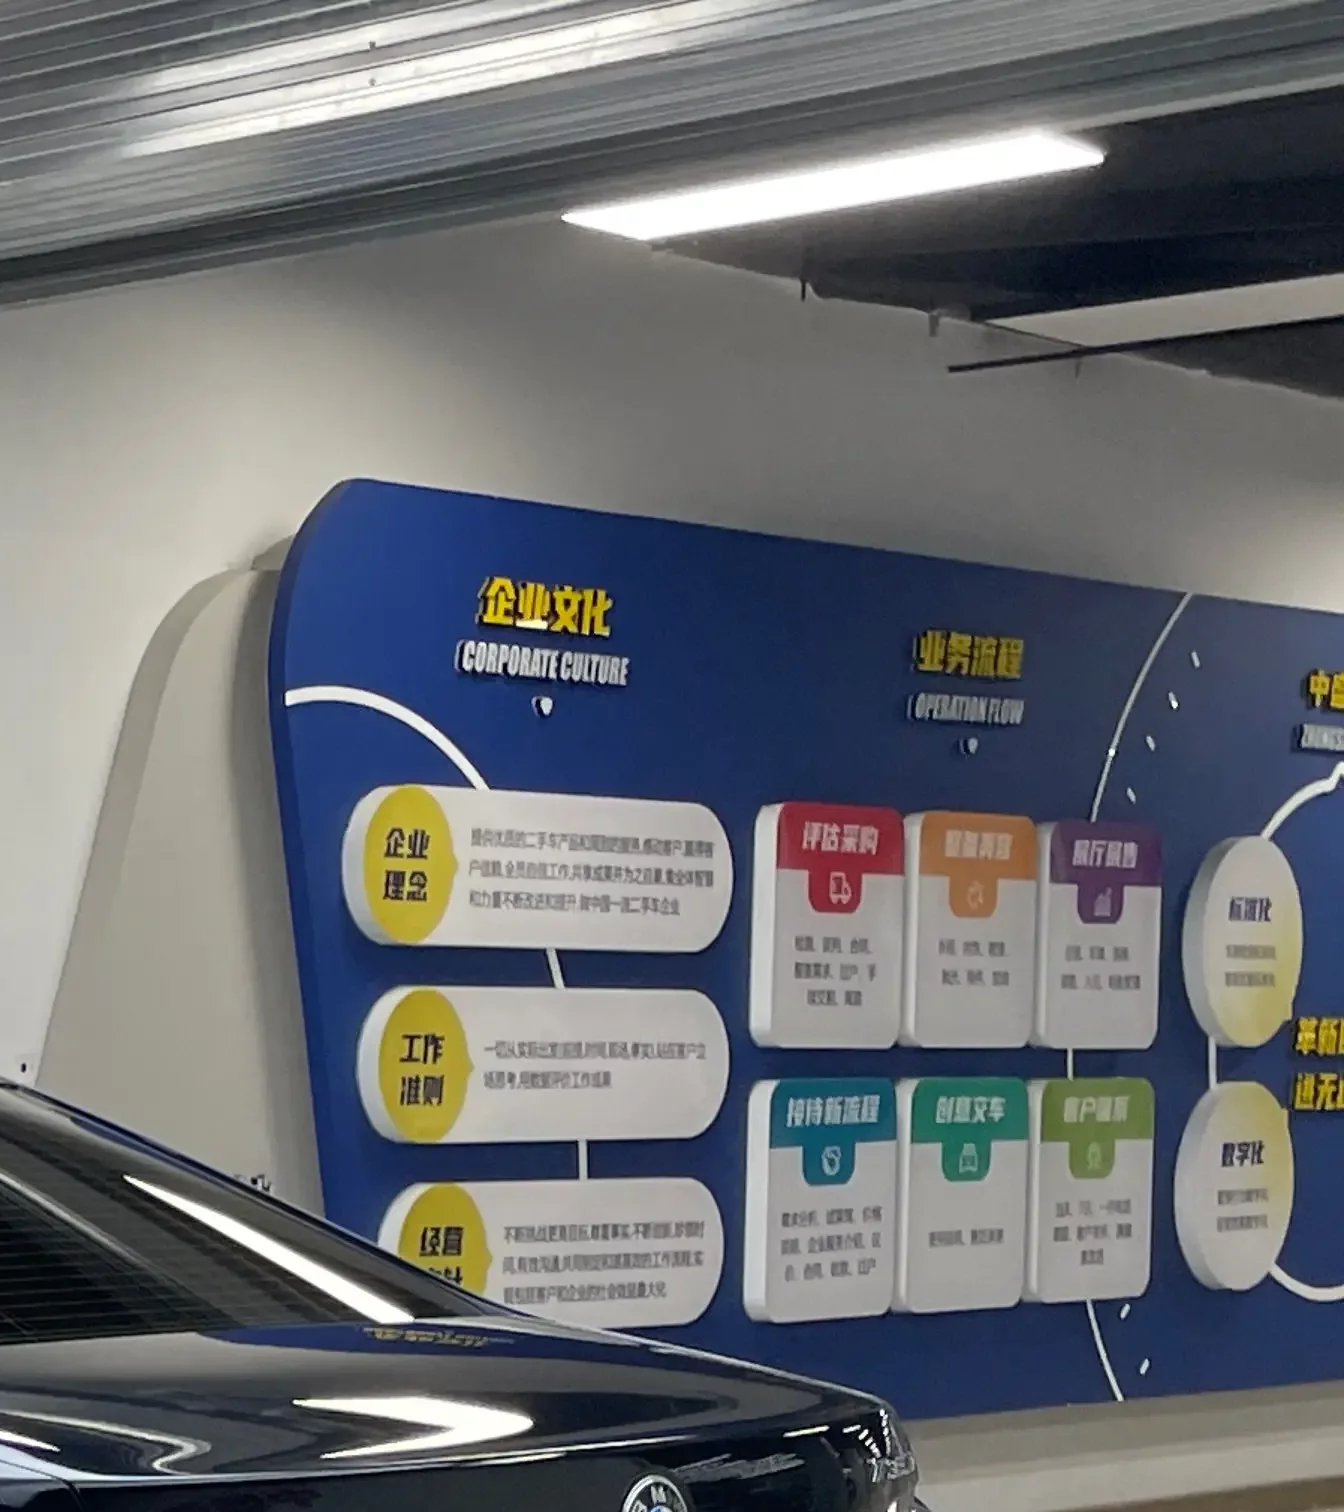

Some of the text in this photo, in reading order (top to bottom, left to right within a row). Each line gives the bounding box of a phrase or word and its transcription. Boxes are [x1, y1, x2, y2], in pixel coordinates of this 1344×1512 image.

[481, 576, 613, 637] 企业文化
[461, 640, 629, 686] CORPORATE CULTURE
[918, 630, 1024, 679] 业务流程
[915, 694, 1025, 725] OPERATION FLOW
[384, 828, 430, 860] 企业
[383, 870, 428, 902] 理念
[400, 1033, 445, 1063] 工作
[400, 1074, 444, 1107] 准则
[419, 1226, 463, 1257] 经营
